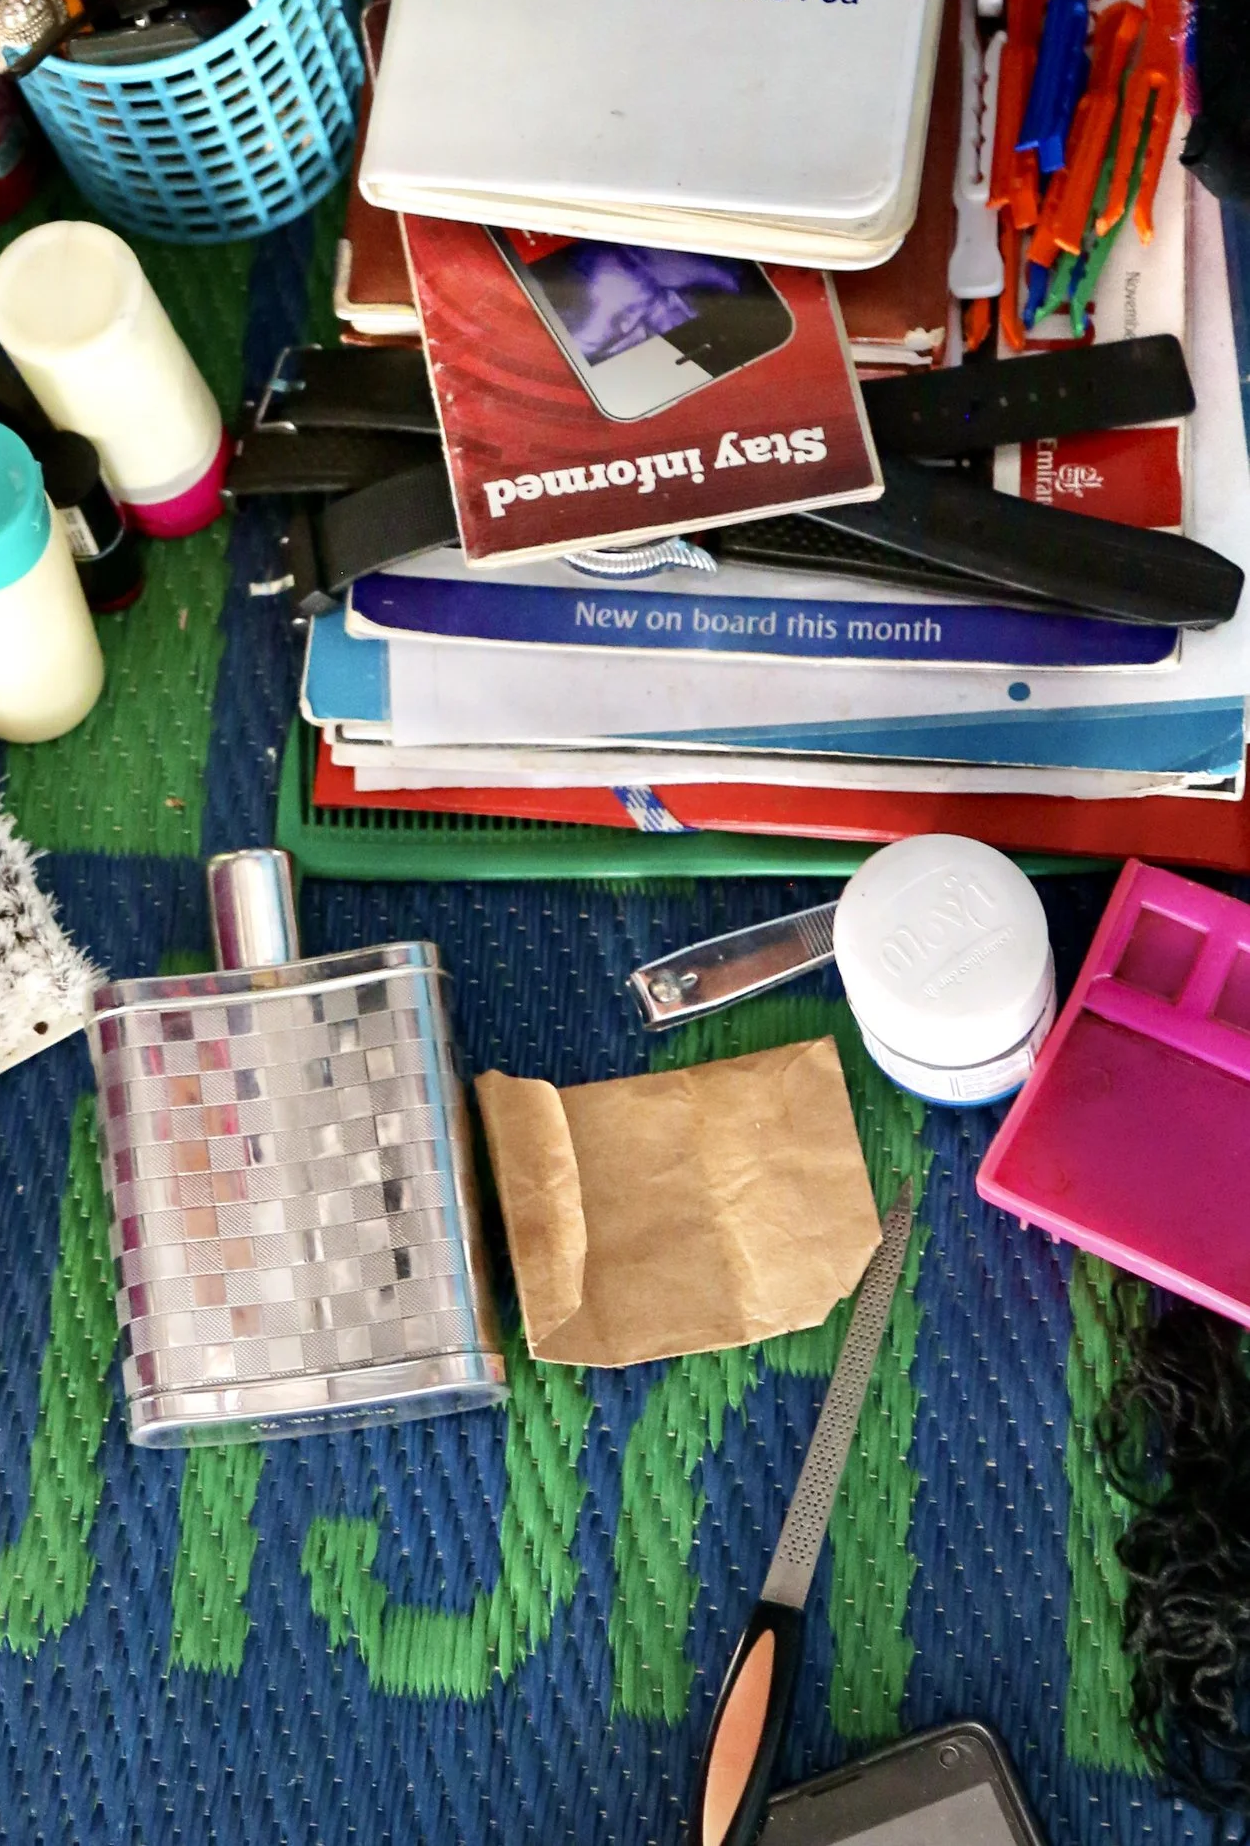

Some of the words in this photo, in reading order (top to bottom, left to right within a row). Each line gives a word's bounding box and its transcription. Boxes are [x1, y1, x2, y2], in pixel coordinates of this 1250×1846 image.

[1124, 270, 1142, 340] Novembe
[714, 426, 828, 470] Stay
[483, 448, 705, 519] informed
[575, 600, 638, 630] New
[646, 610, 682, 632] on
[693, 607, 778, 637] board
[787, 612, 839, 640] this
[848, 617, 943, 644] month
